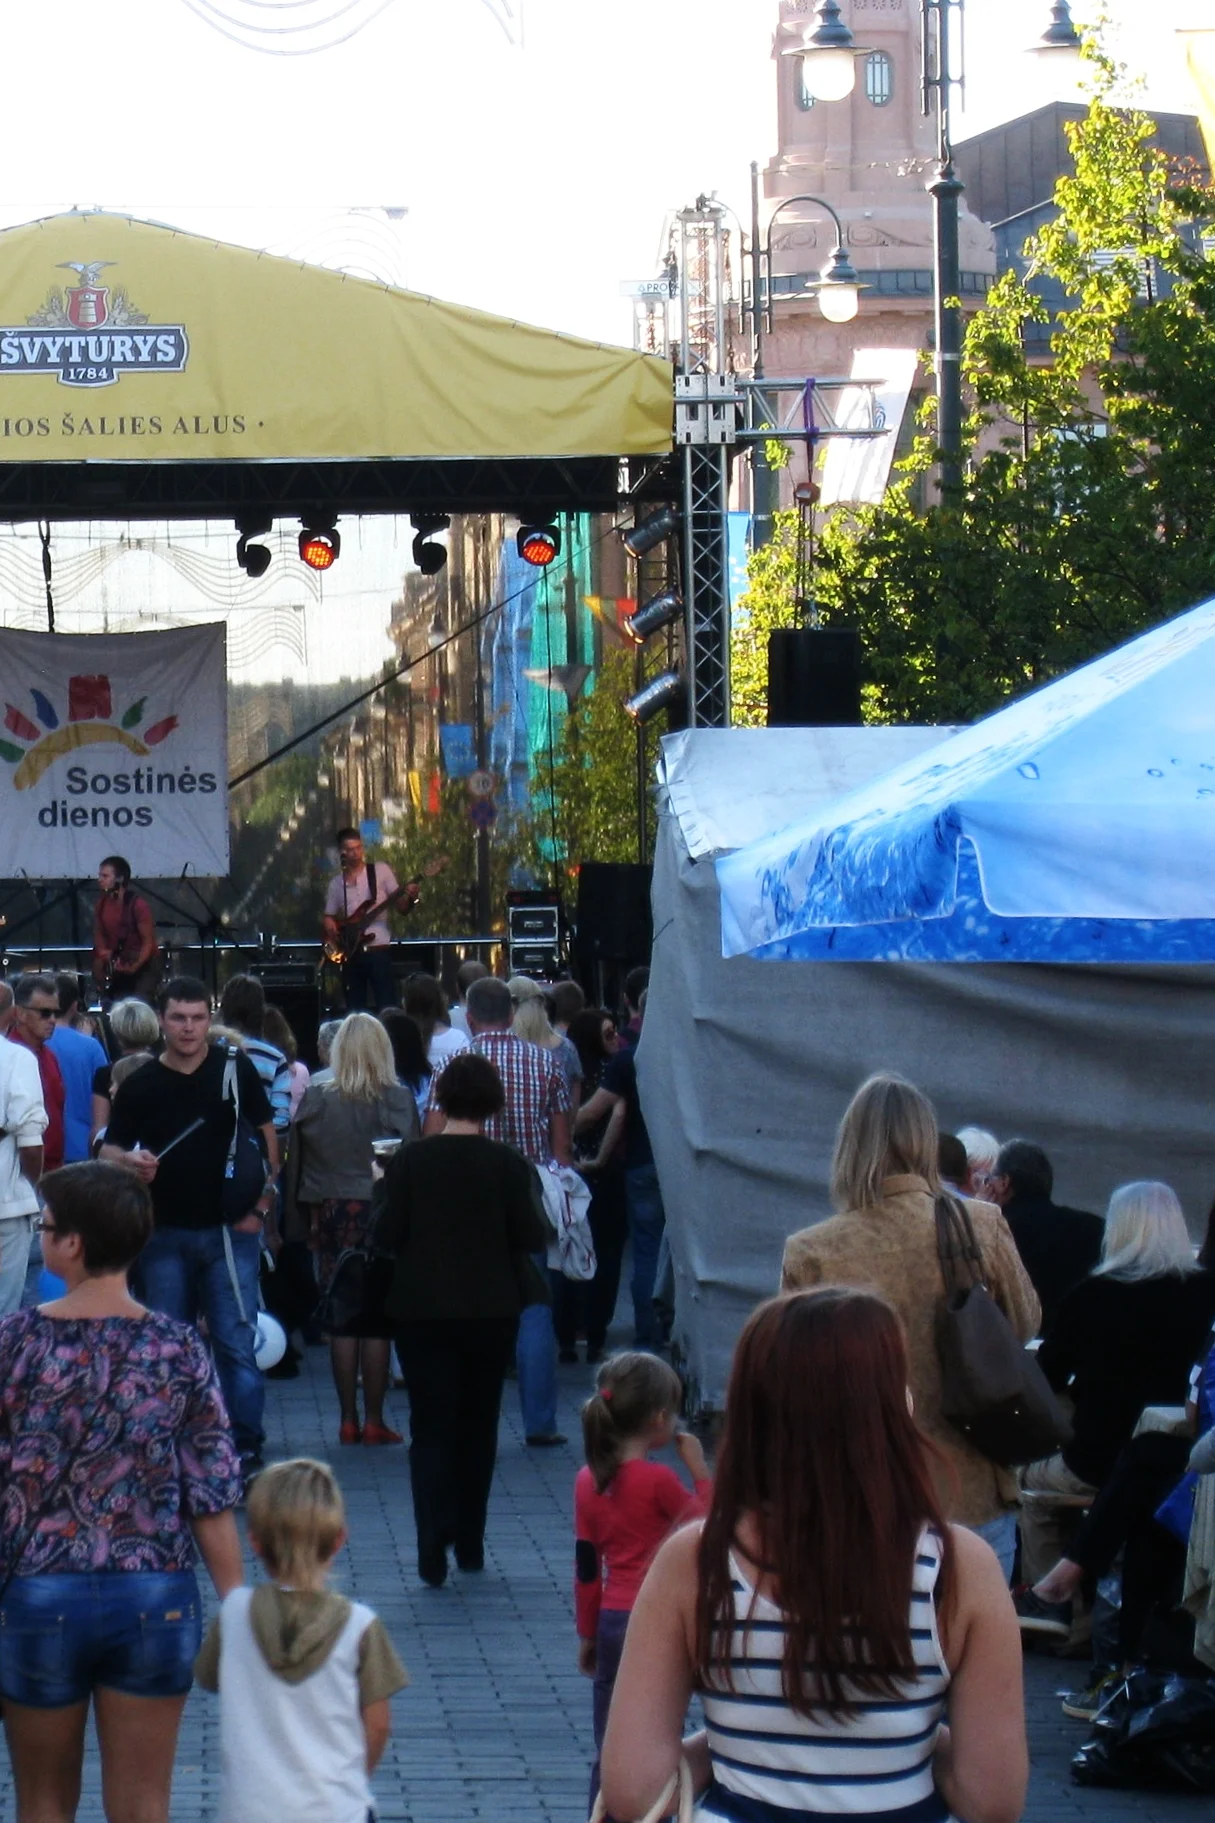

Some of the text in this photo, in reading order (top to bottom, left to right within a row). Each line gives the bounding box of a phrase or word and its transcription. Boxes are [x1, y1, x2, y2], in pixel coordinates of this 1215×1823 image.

[0, 331, 176, 364] ŠVYTURYS
[68, 367, 109, 380] 1784
[61, 412, 163, 436] ŠALIES
[172, 415, 246, 434] ALUS
[66, 765, 217, 795] Sostinės
[38, 800, 153, 827] dienos
